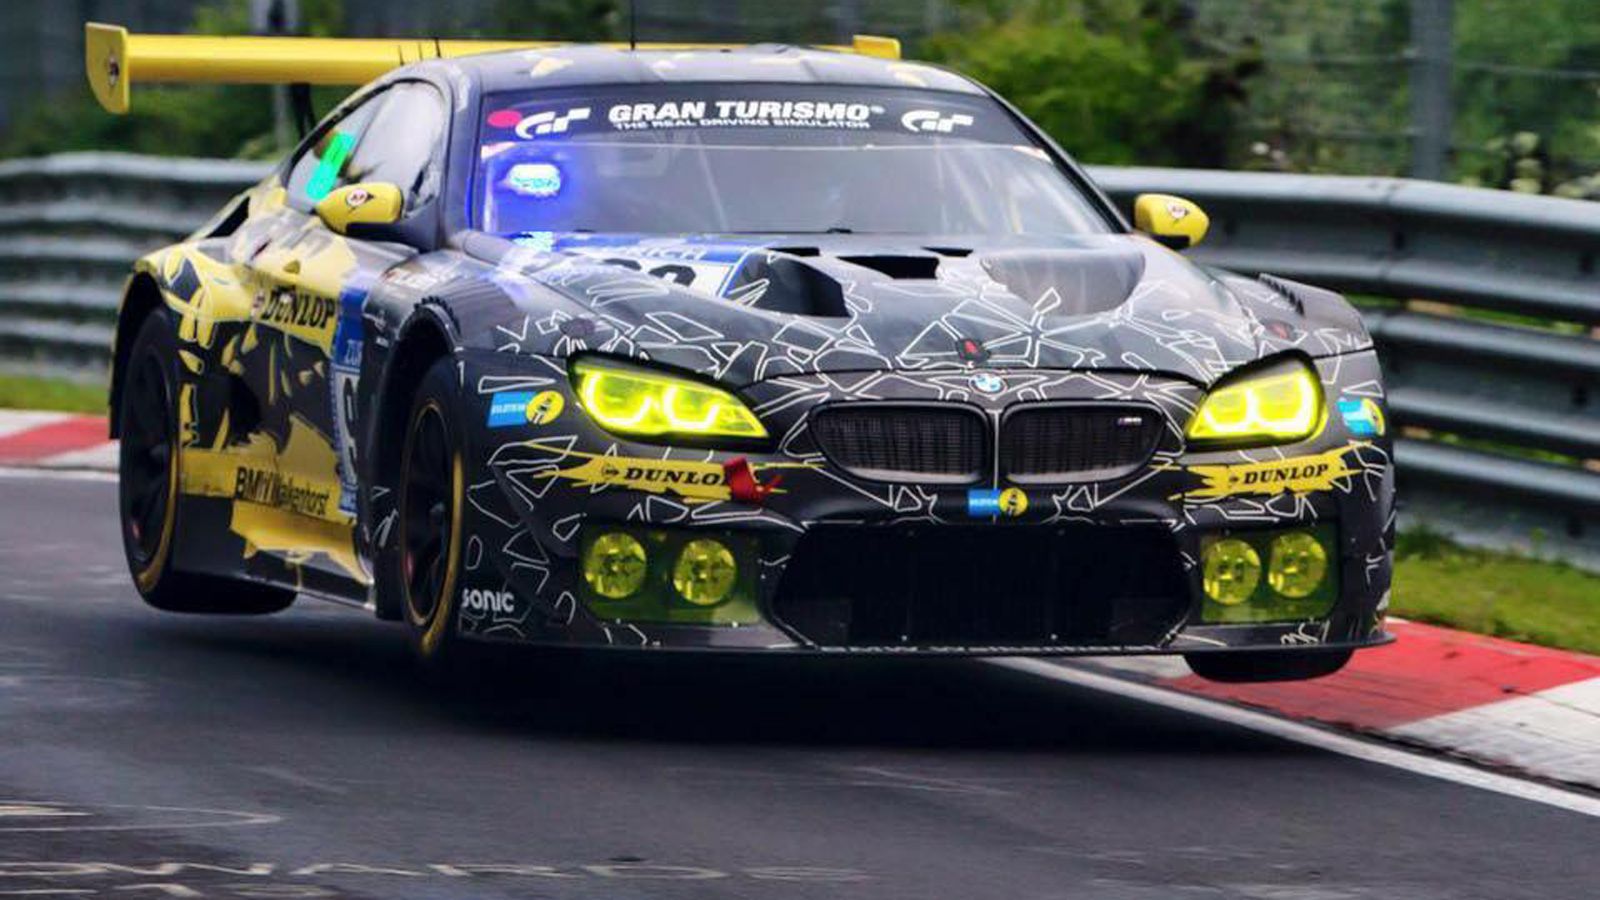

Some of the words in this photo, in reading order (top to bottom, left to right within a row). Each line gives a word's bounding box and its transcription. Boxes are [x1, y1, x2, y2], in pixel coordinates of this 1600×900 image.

[608, 101, 706, 124] GRAN
[651, 119, 698, 128] REAL
[700, 118, 770, 127] DRIVING
[773, 118, 871, 129] SIMULATOR
[261, 286, 336, 330] DUNLOP
[623, 466, 732, 487] DUNLO
[1243, 464, 1329, 485] DUNLOP
